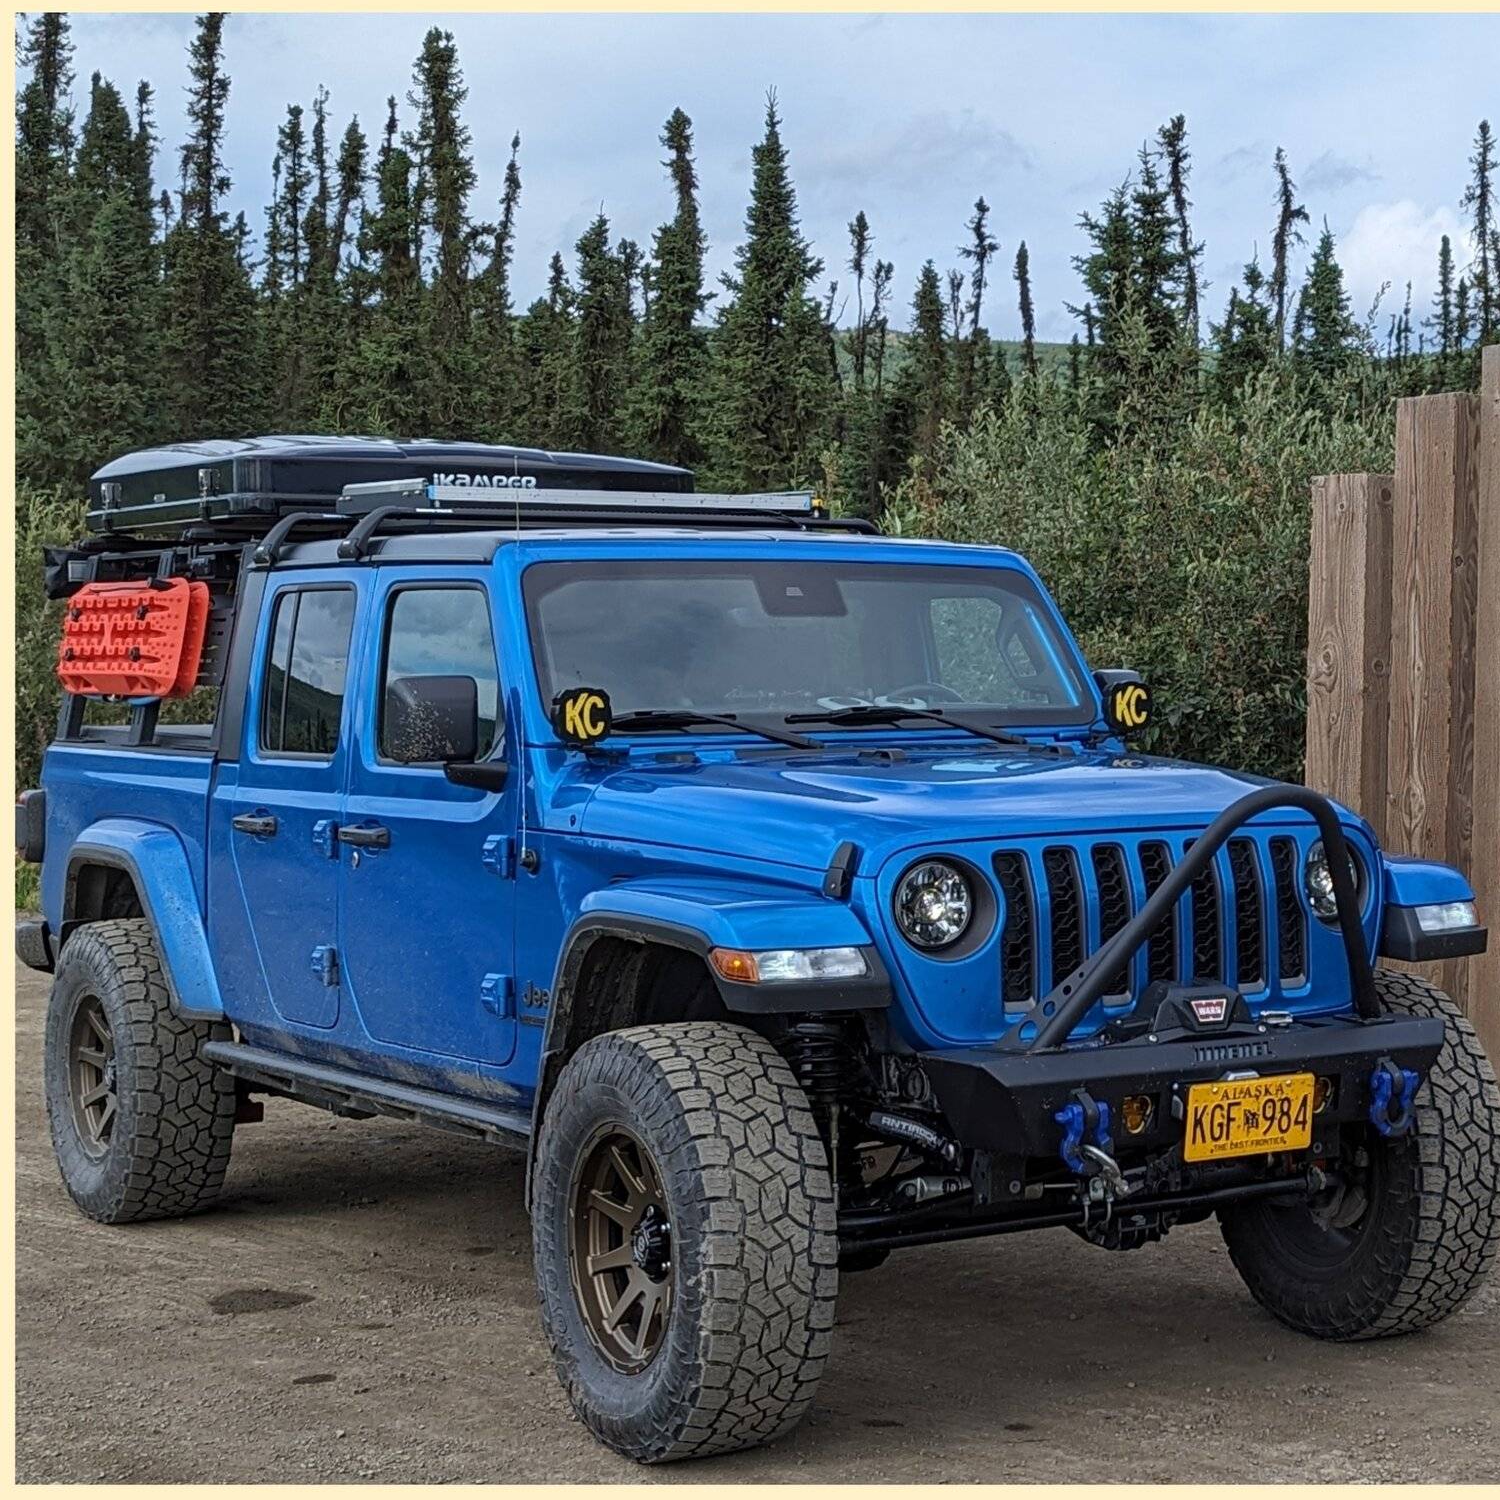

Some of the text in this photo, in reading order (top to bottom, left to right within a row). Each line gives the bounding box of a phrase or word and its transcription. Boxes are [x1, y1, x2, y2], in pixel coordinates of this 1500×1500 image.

[566, 692, 605, 739] KC
[1116, 685, 1148, 727] KC
[523, 979, 550, 1008] Jee
[1221, 1083, 1285, 1101] ALASKA
[1191, 1092, 1311, 1146] KGF 984
